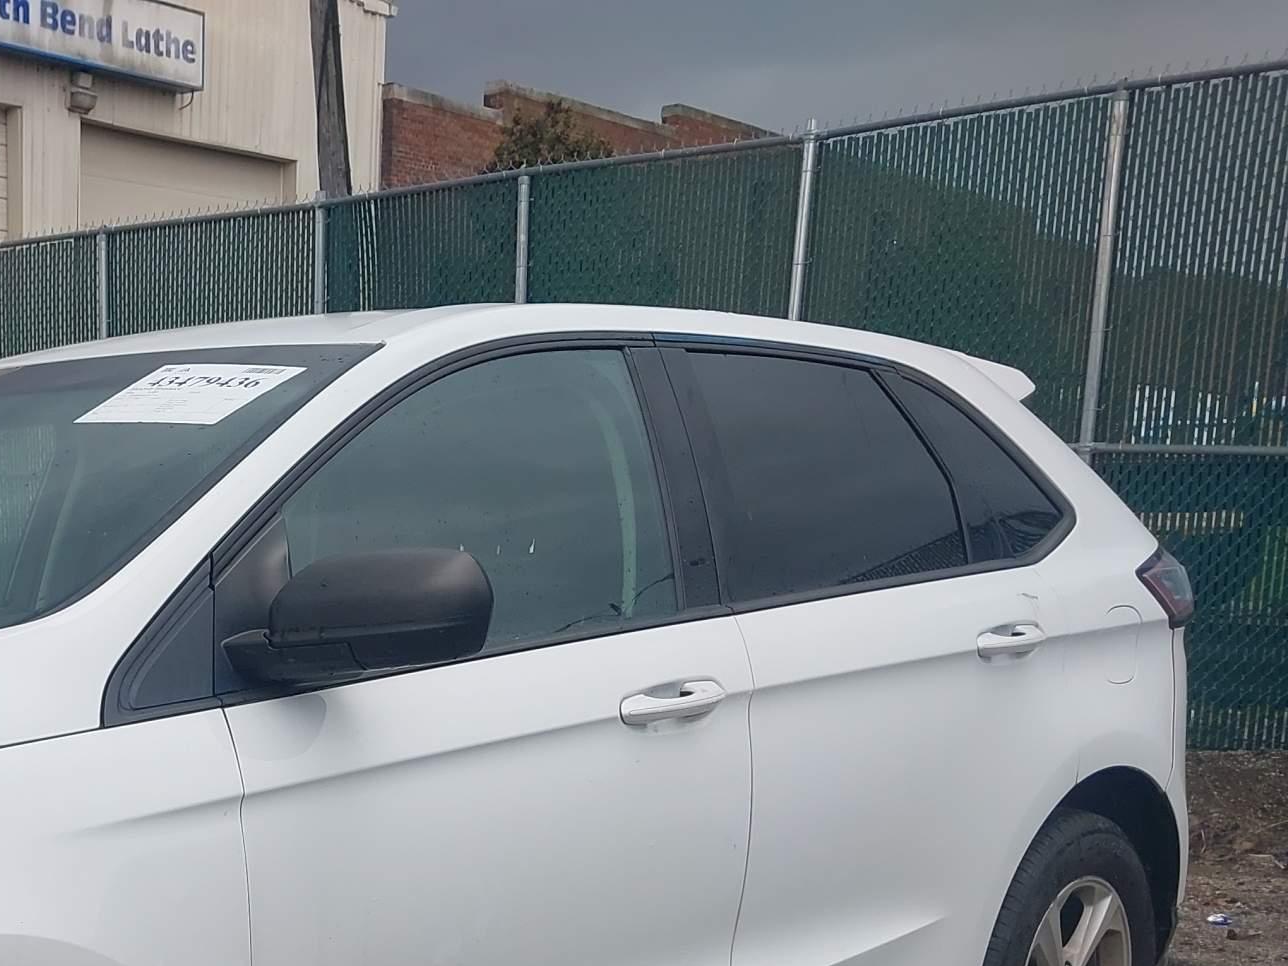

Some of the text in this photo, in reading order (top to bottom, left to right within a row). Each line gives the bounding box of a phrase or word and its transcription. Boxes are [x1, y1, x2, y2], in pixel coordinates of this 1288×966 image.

[39, 1, 112, 45] Bend
[121, 20, 196, 64] Lathe
[148, 376, 266, 388] 43479436
